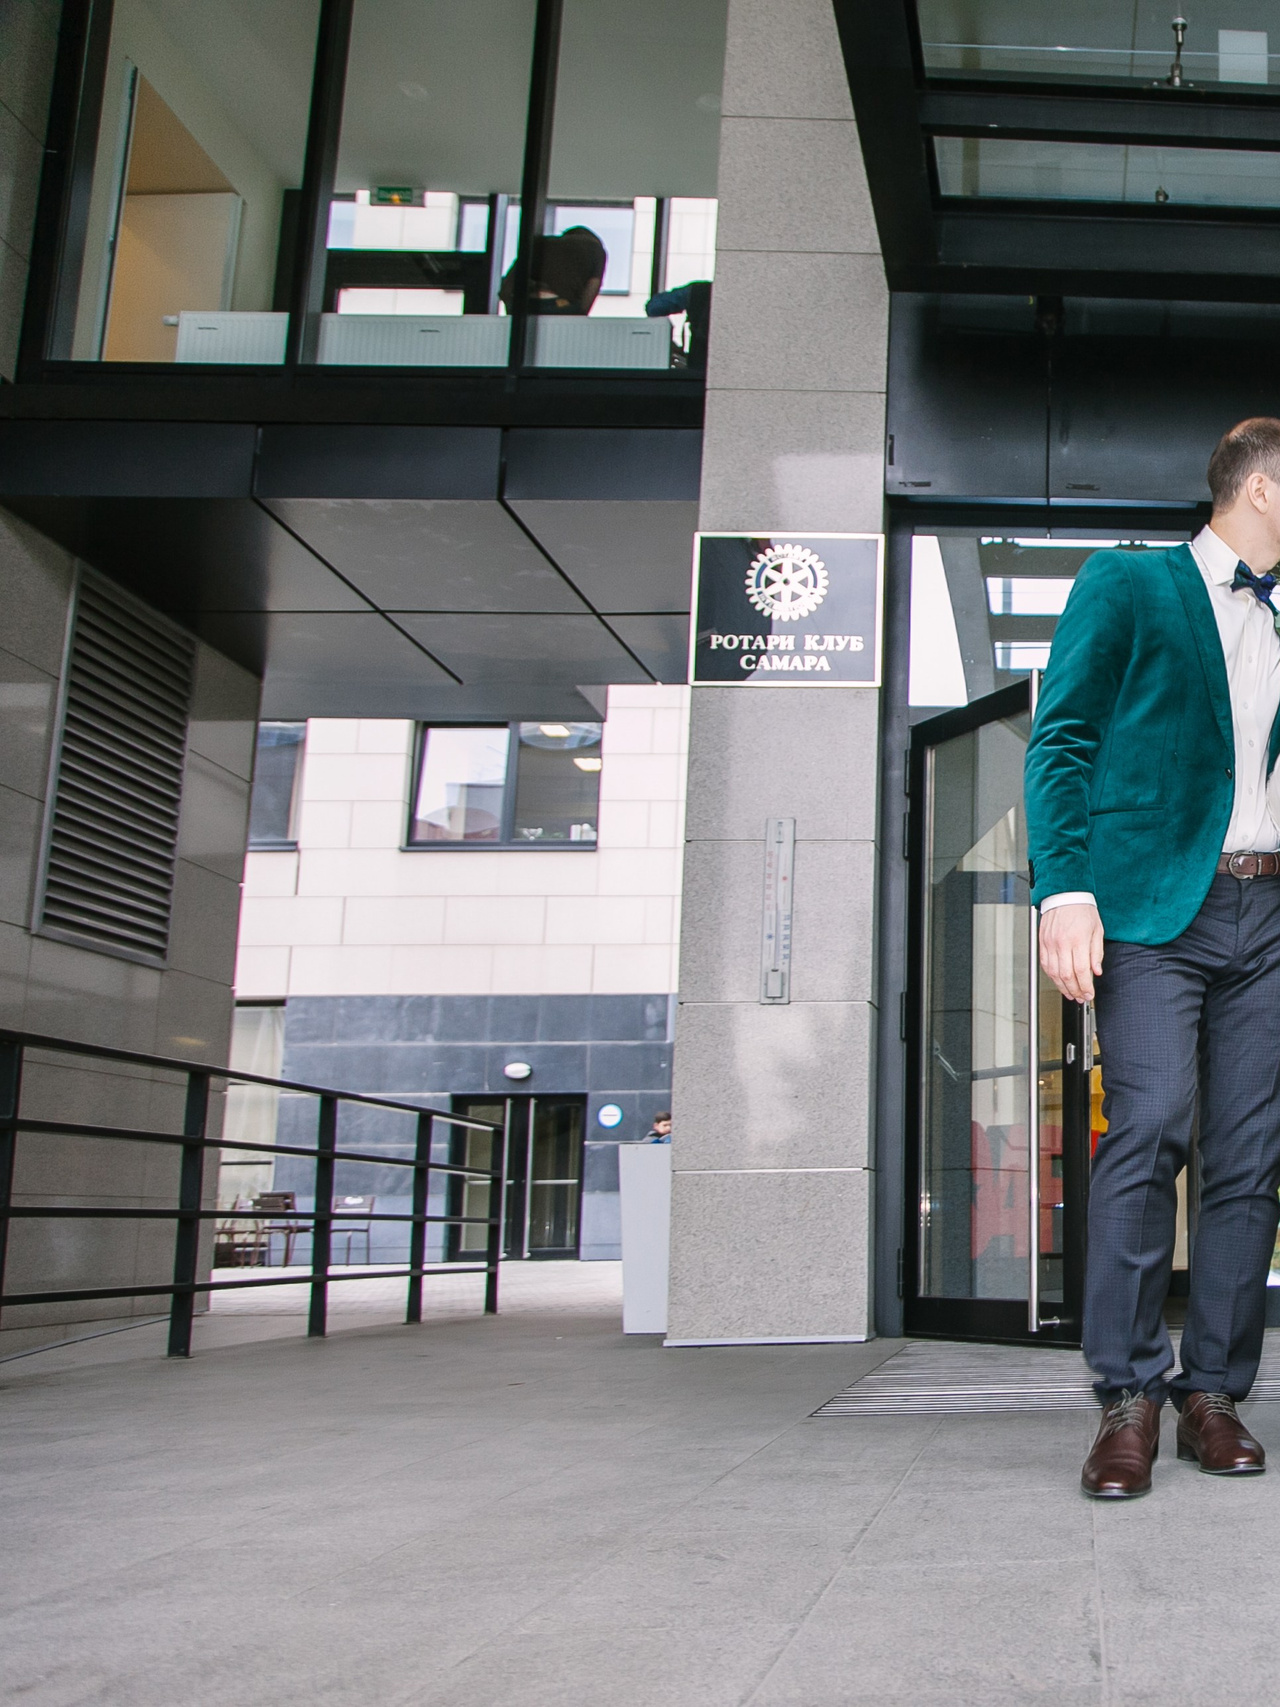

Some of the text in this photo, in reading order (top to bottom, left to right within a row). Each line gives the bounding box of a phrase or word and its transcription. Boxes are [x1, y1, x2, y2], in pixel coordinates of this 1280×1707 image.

[709, 634, 865, 652] РОТАРИ КЛУБ
[739, 655, 831, 672] САМАРА
